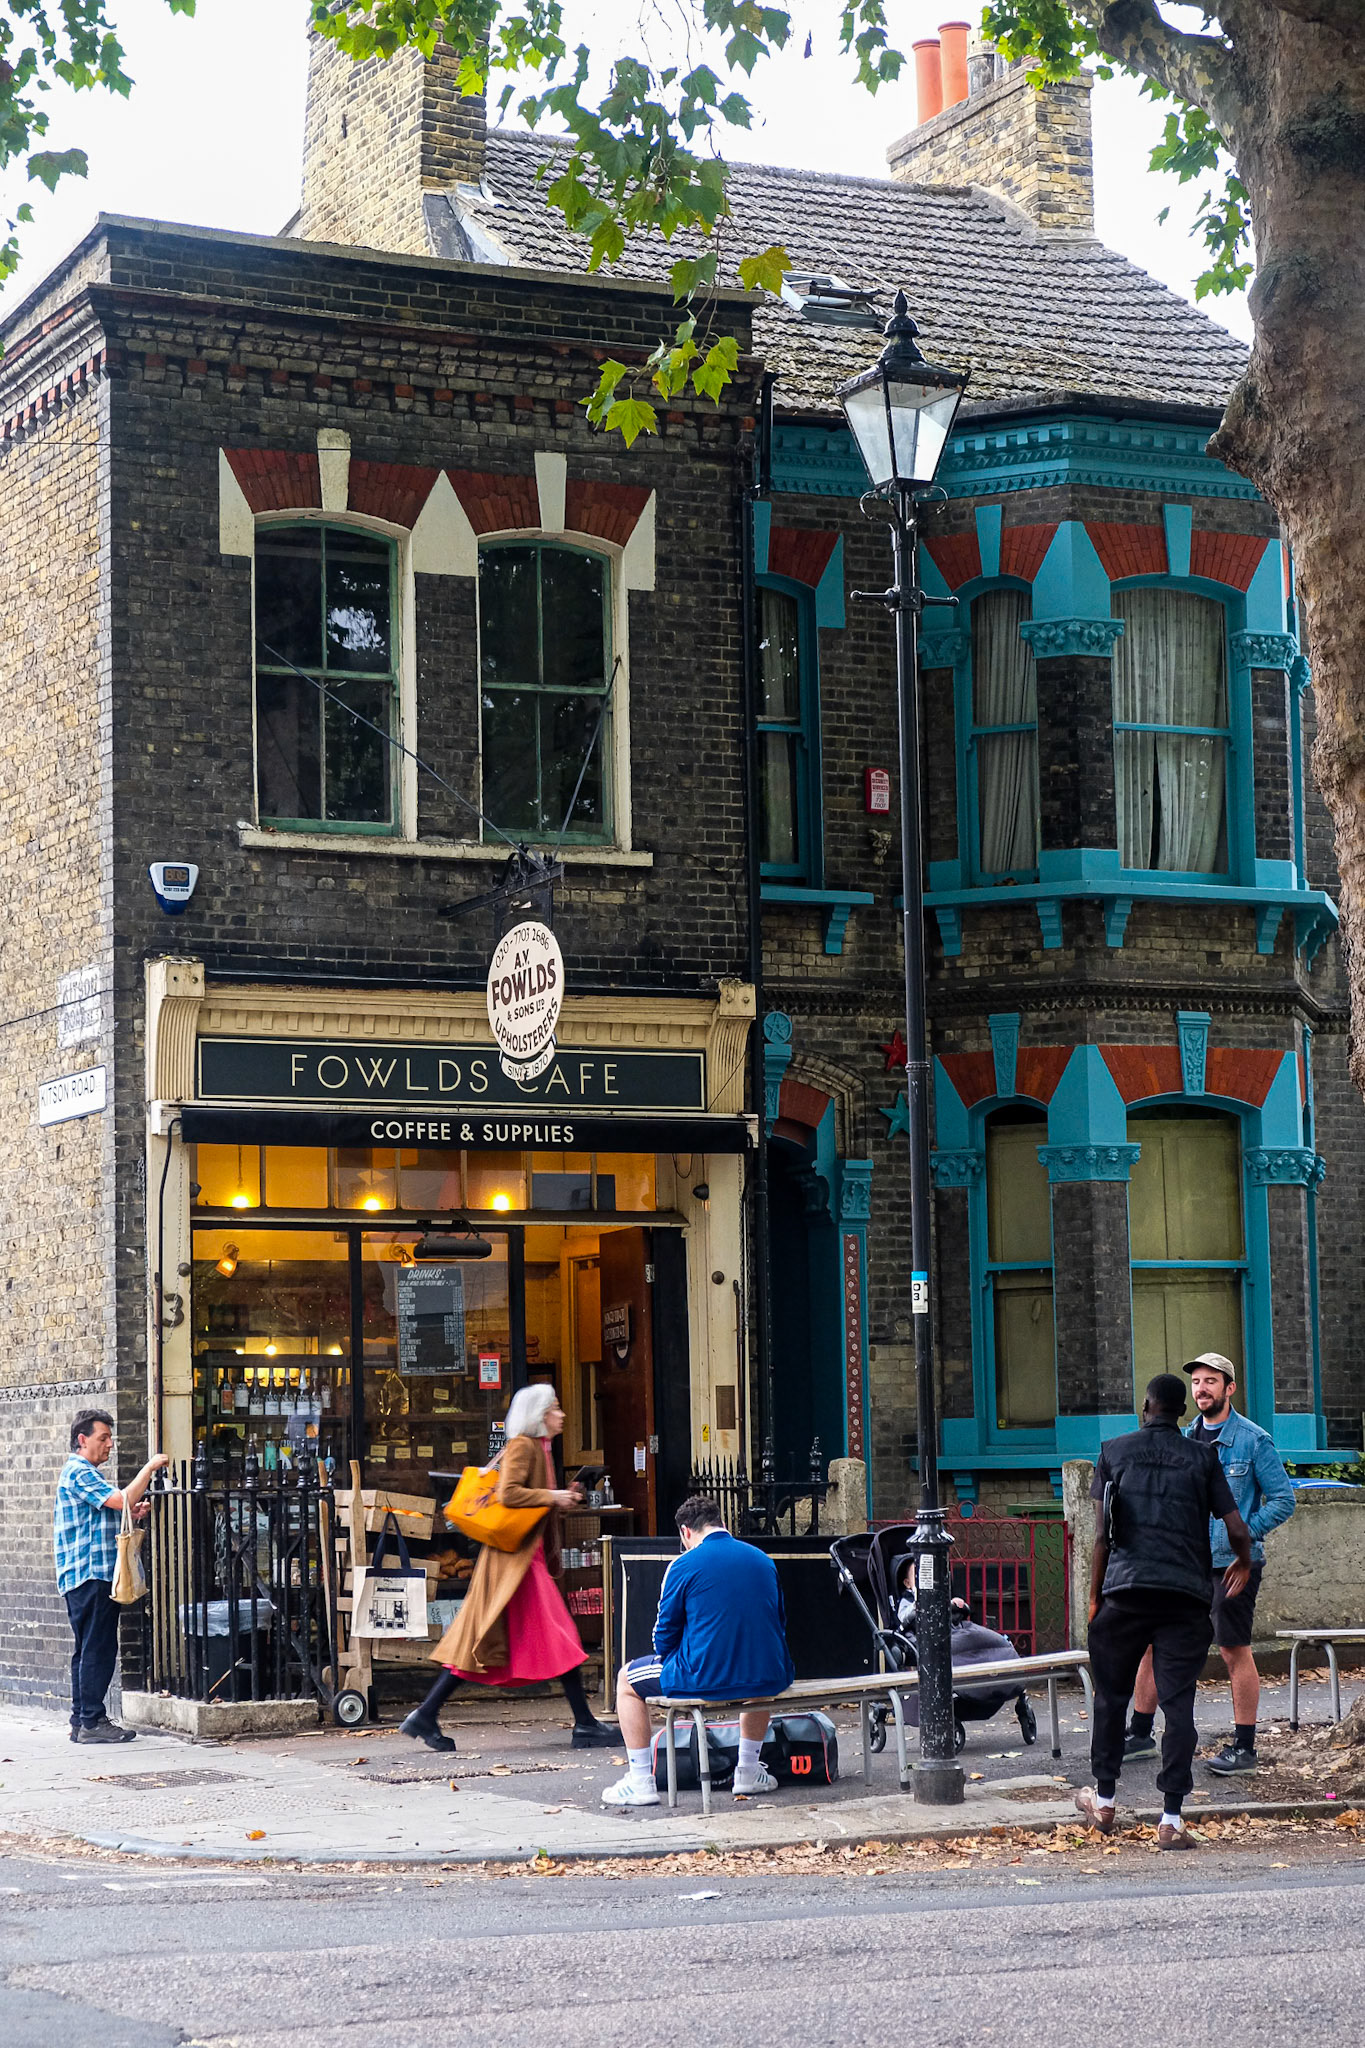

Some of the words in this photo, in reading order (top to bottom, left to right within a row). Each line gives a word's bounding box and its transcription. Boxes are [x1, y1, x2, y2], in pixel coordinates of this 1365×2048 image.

[532, 928, 550, 951] 2686
[514, 948, 530, 970] A.V.
[491, 958, 556, 1010] FOWLDS
[507, 1010, 512, 1022] &
[514, 1001, 534, 1020] SONS
[495, 997, 558, 1052] UPHOLSTERERS
[291, 1053, 489, 1093] FOWLDS
[532, 1053, 548, 1076] 1870
[41, 1081, 69, 1106] KITSON
[71, 1075, 96, 1099] ROAD
[370, 1120, 451, 1141] COFFEE
[460, 1123, 475, 1141] &
[483, 1124, 574, 1143] SUPPLIES
[162, 1293, 185, 1328] 3
[790, 1755, 812, 1774] W
